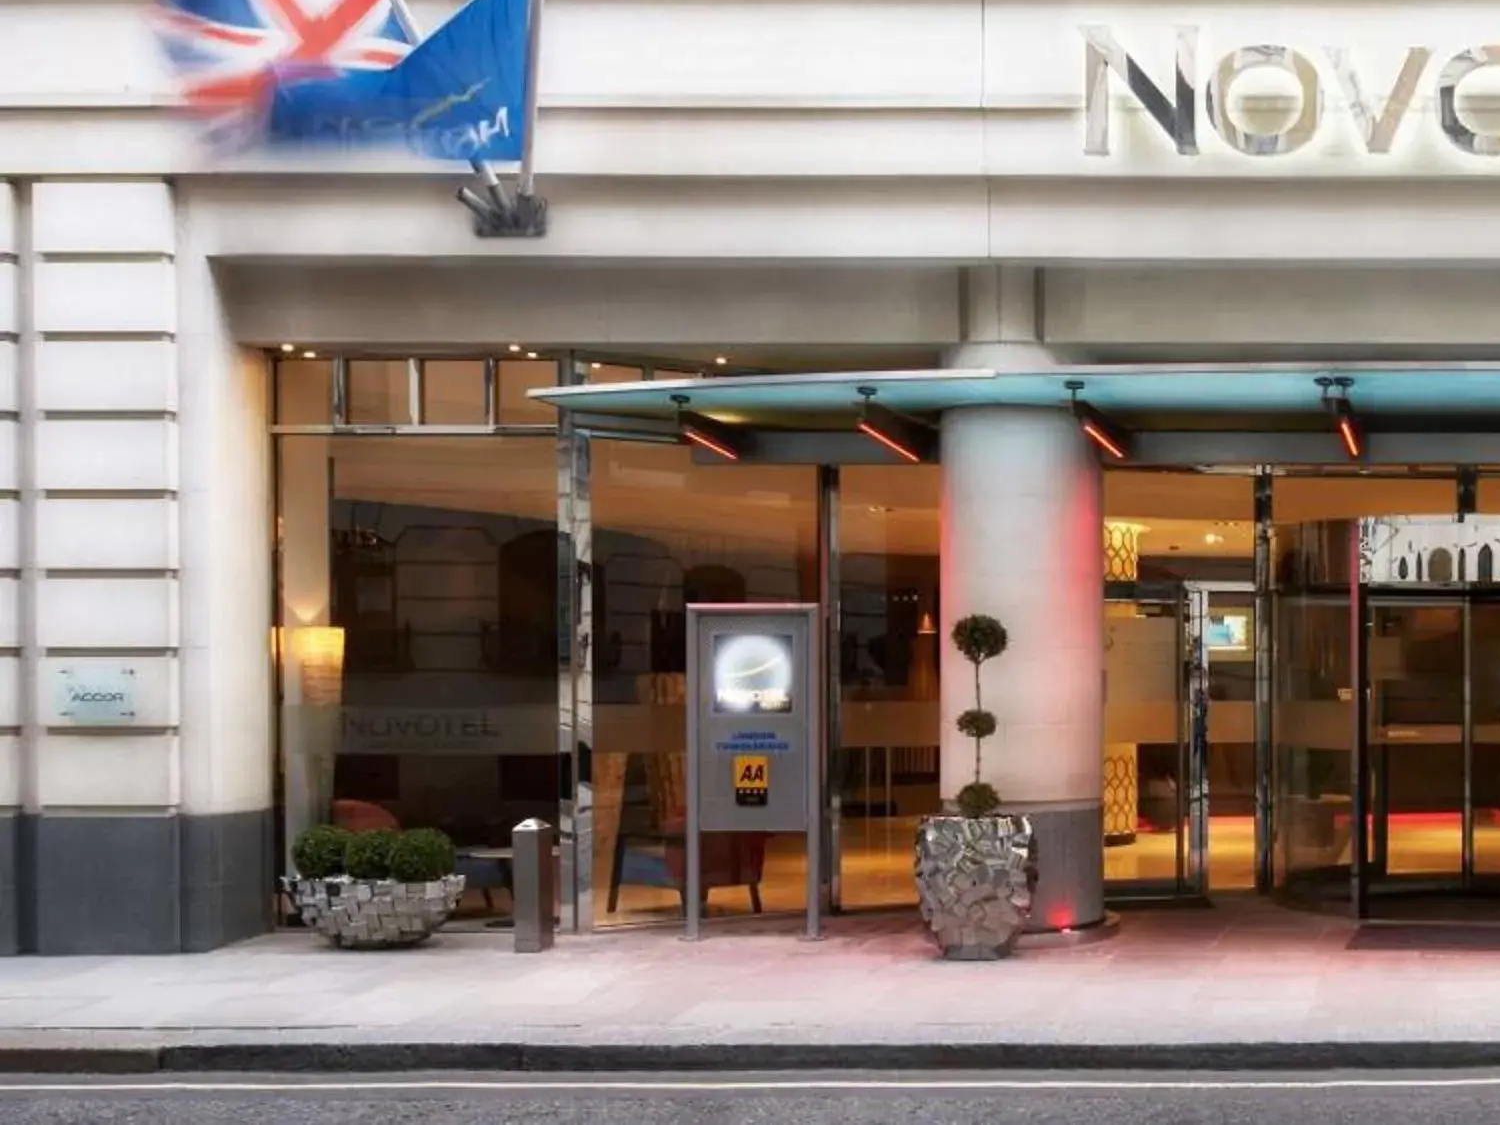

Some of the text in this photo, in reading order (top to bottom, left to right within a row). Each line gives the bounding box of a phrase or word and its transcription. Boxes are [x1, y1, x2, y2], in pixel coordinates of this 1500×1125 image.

[71, 691, 124, 702] ACCOR
[341, 710, 502, 737] NOVOTEL
[740, 764, 765, 782] AA
